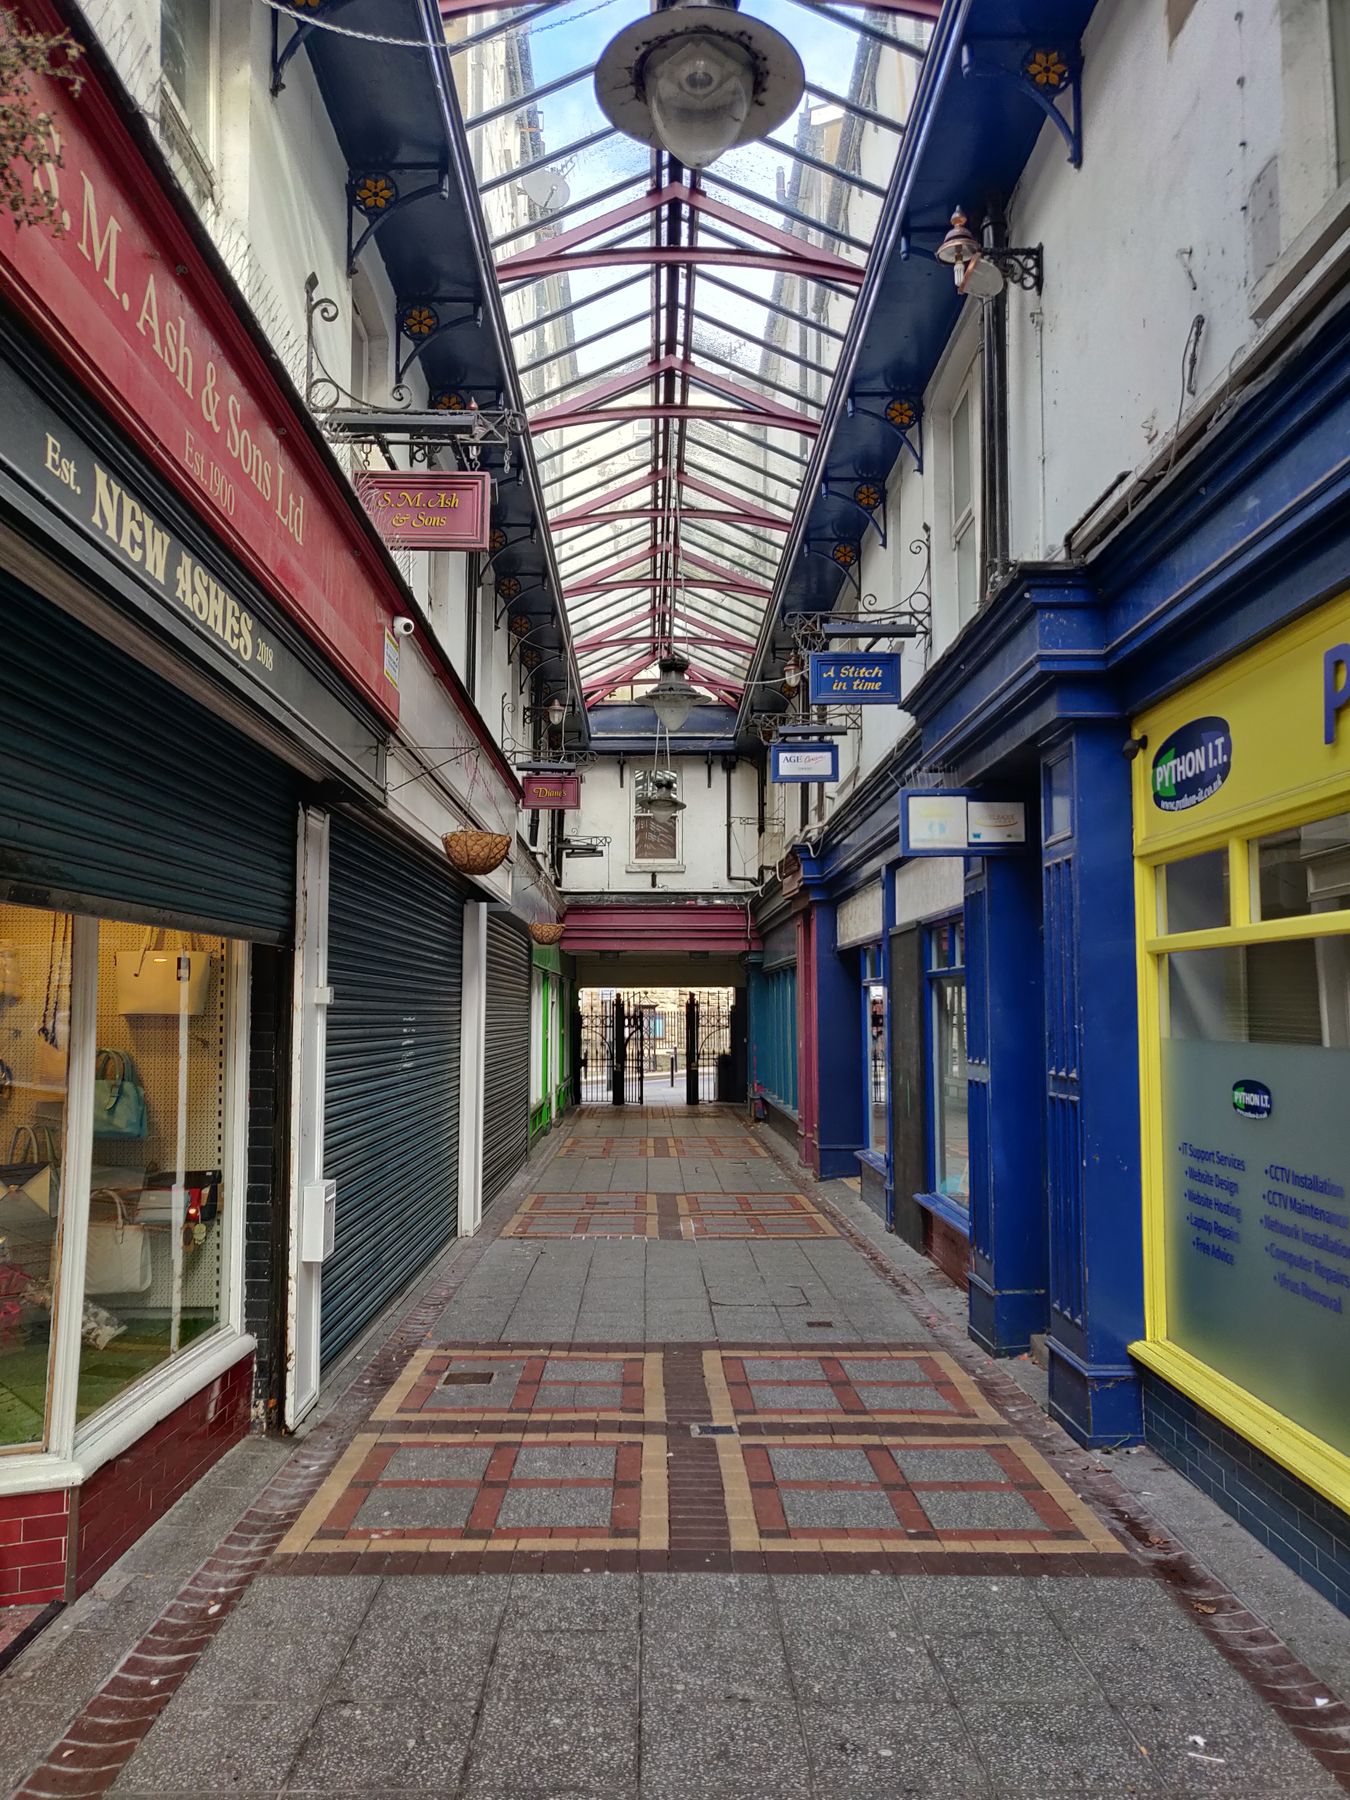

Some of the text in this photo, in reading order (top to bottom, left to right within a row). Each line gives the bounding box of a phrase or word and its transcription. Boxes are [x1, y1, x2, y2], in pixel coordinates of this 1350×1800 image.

[136, 273, 194, 400] Ash
[201, 361, 221, 433] &
[227, 394, 273, 501] Sons
[275, 464, 305, 546] Ltd
[209, 461, 235, 516] 1900
[391, 511, 448, 529] & Sons
[44, 431, 275, 672] Est. NEW ASHES 2018
[822, 665, 883, 679] A Stitch
[832, 678, 882, 691] in time
[1155, 736, 1228, 791] PYTHON I.T.
[1181, 1142, 1246, 1172] IT Support Services
[1188, 1167, 1239, 1197] Website Design
[1269, 1165, 1291, 1184] CCTV
[1187, 1189, 1242, 1223] Website Hosting
[1267, 1190, 1288, 1210] CCTV
[1190, 1213, 1213, 1236] Laptop
[1195, 1236, 1211, 1256] Free
